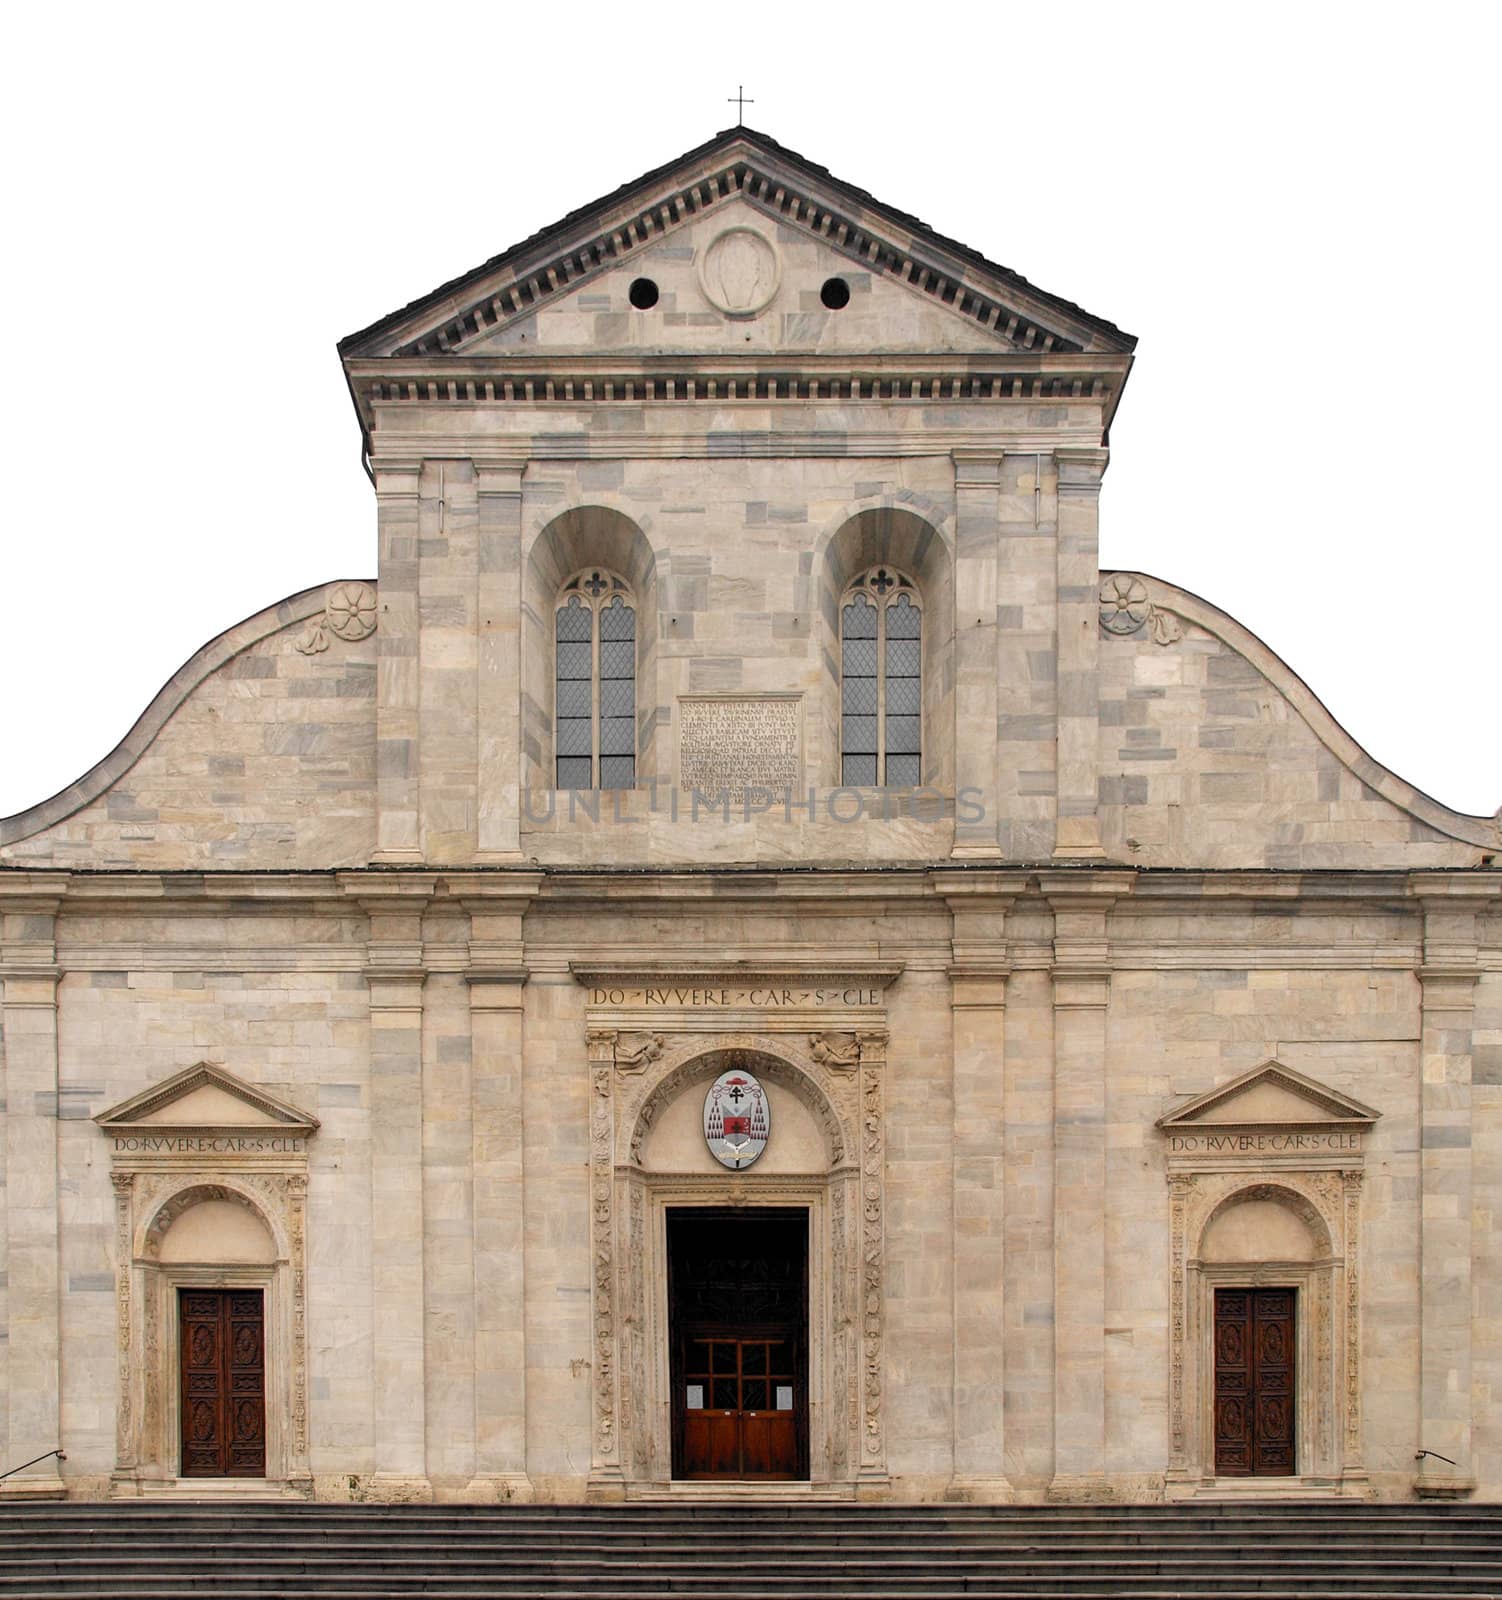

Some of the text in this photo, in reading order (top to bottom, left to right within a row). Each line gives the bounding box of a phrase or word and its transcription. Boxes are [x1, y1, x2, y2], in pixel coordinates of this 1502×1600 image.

[593, 989, 879, 1005] DO RVVERE CAR S CLE
[1172, 1134, 1358, 1152] DO RVVERE CAR S CLE
